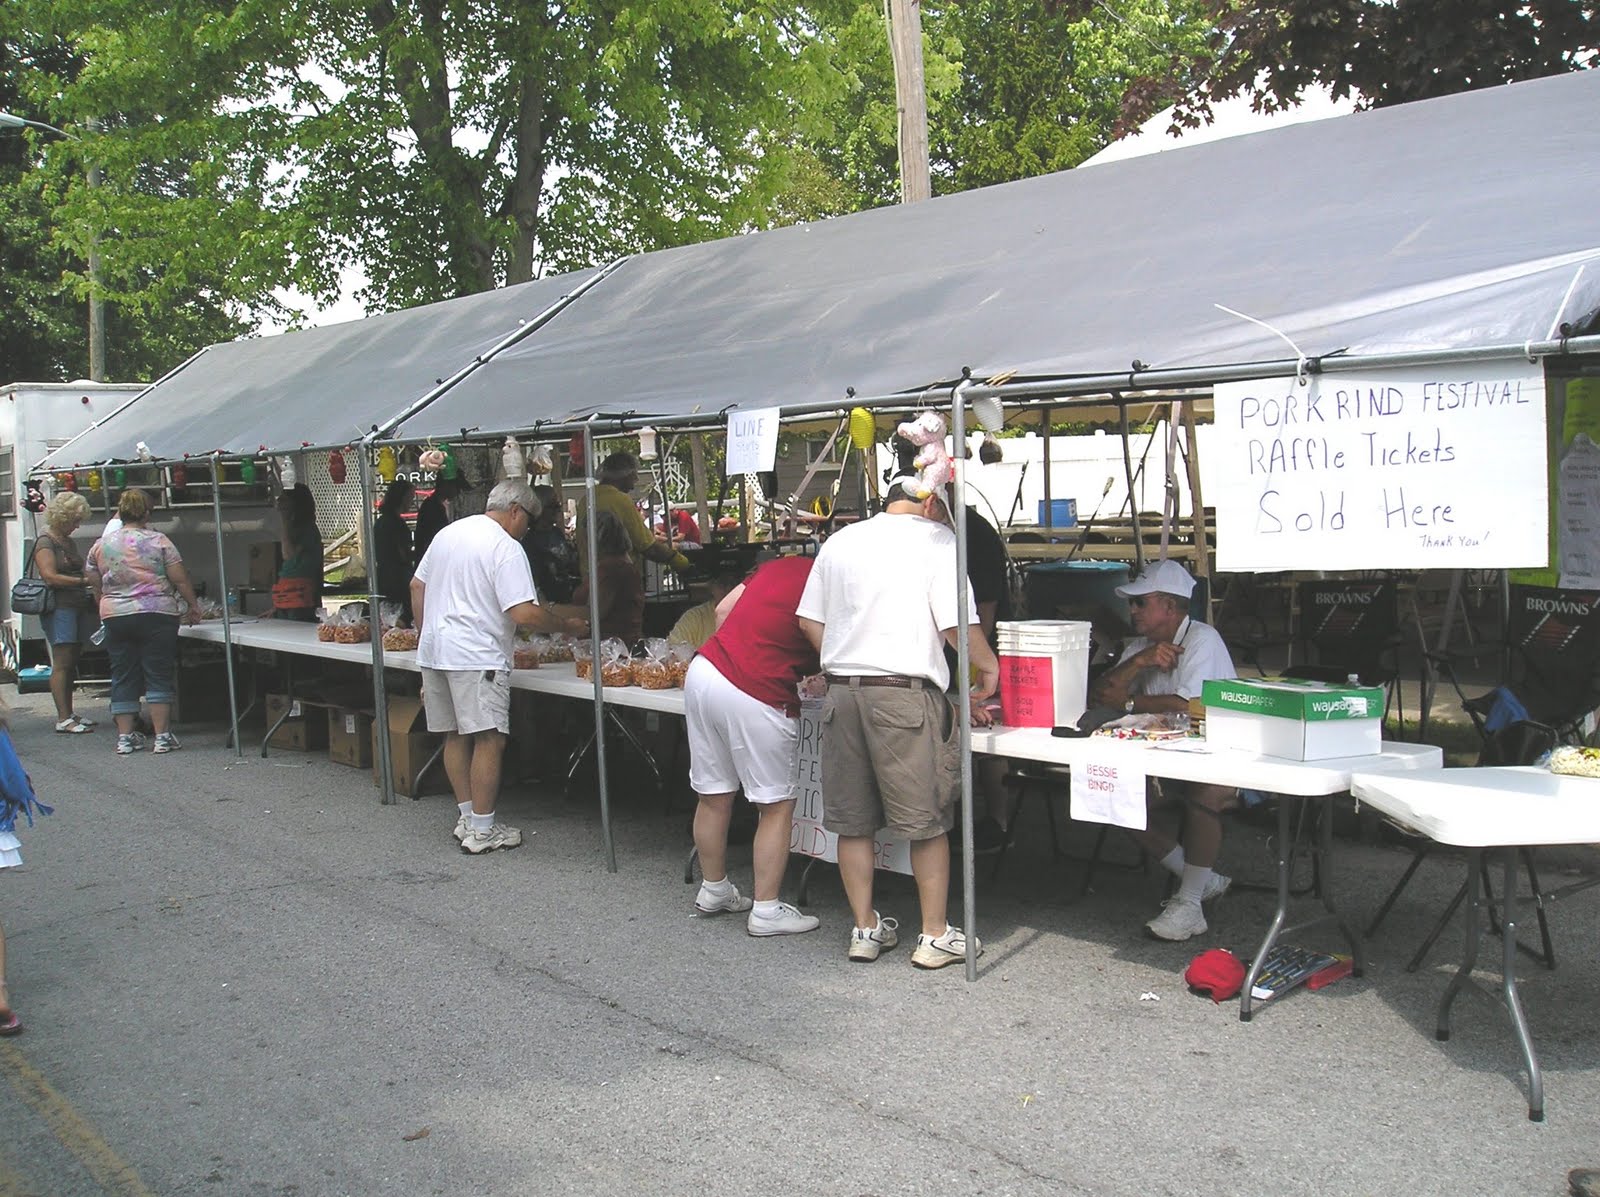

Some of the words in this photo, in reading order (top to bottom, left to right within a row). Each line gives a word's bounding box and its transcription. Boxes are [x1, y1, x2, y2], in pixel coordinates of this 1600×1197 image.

[1240, 393, 1324, 429] PORK
[1337, 387, 1404, 419] RIND
[1422, 380, 1529, 412] FESTIVAL
[735, 418, 765, 437] LINE
[1361, 427, 1456, 466] Tickets
[1259, 489, 1345, 534] Sold
[1382, 487, 1455, 530] Here
[1315, 591, 1371, 606] BROWNS
[1526, 597, 1590, 616] BROWNS
[1086, 763, 1119, 779] BESSIE
